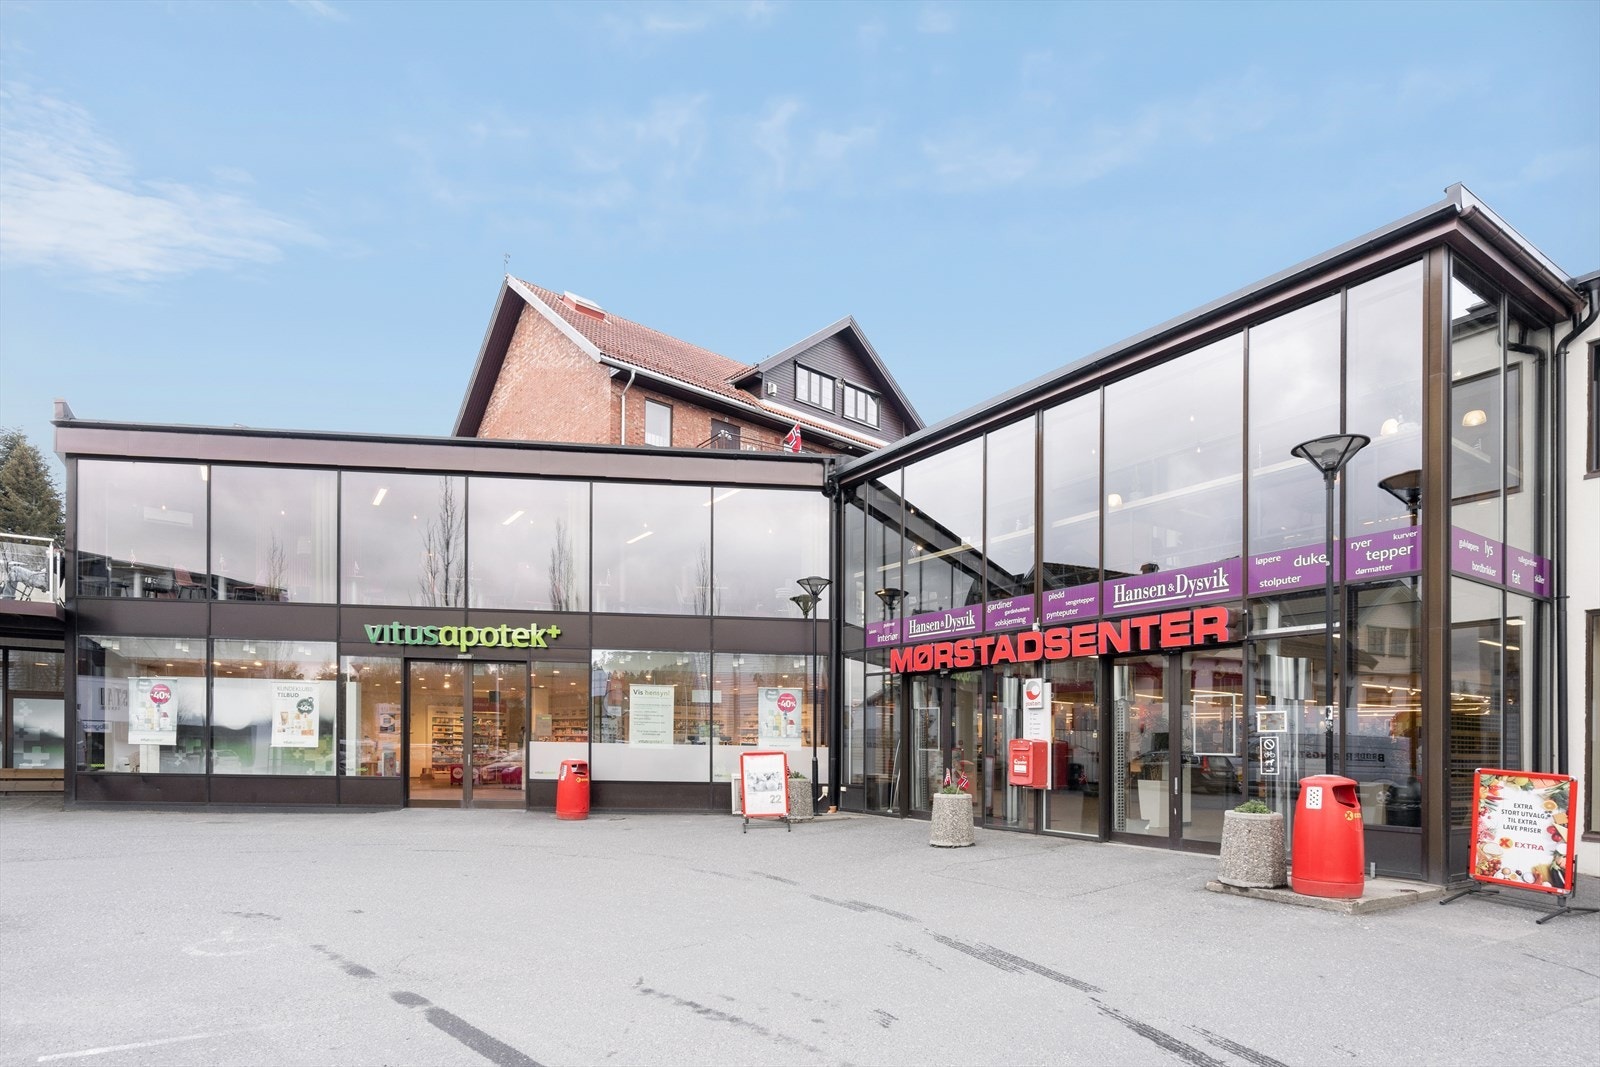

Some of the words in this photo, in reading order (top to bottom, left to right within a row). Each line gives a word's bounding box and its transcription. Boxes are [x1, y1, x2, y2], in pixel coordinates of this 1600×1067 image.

[1392, 530, 1418, 540] kurver
[1350, 539, 1372, 551] ryer
[1484, 540, 1494, 558] lys
[1366, 544, 1414, 562] tepper
[1255, 554, 1281, 566] løpere
[1294, 553, 1327, 567] duke
[1355, 564, 1392, 575] dørmatter
[1259, 574, 1302, 588] stolputer
[1512, 570, 1520, 584] fat
[1113, 583, 1166, 604] Hansen
[1168, 583, 1176, 592] &
[1176, 567, 1230, 598] Dysvik
[1048, 591, 1065, 602] pledd
[987, 600, 1013, 614] gardiner
[1046, 608, 1078, 620] pynteputer
[908, 619, 940, 634] Hansen
[945, 610, 976, 632] Dysvik
[877, 633, 898, 642] interiør
[889, 606, 1230, 674] MØRSTADSENTER
[150, 691, 171, 700] -40%
[778, 700, 796, 708] -40%
[770, 794, 782, 804] 22
[1514, 842, 1545, 851] EXTRA
